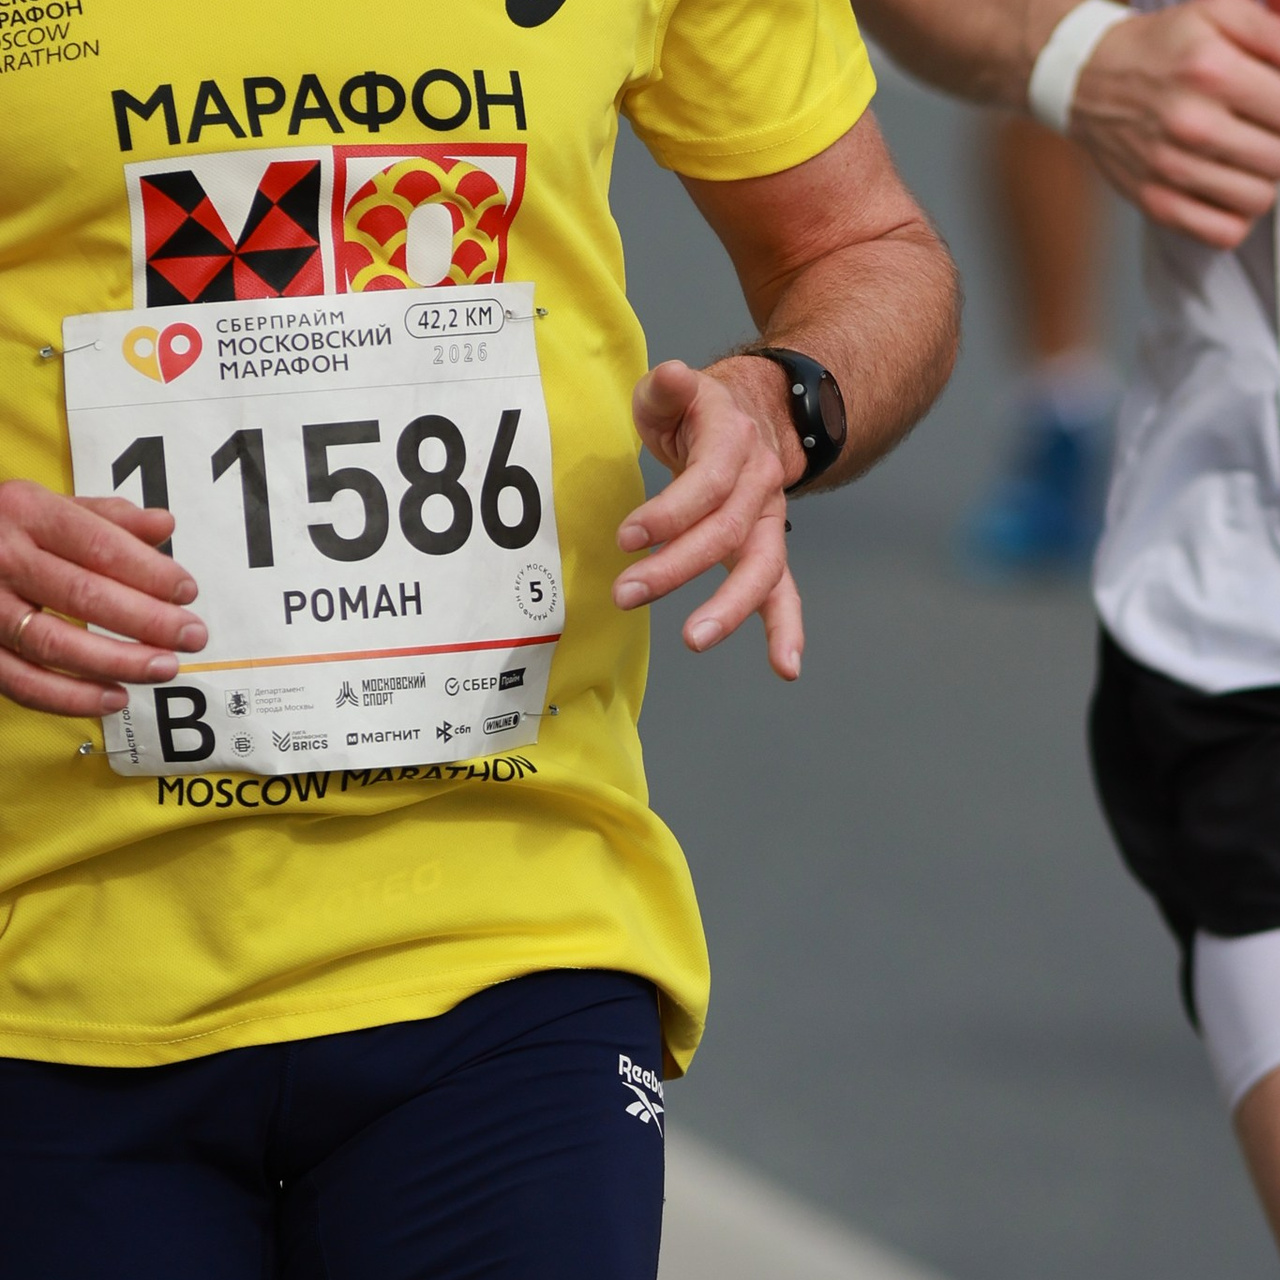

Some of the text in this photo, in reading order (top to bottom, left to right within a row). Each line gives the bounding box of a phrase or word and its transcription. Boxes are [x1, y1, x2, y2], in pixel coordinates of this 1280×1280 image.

[0, 39, 99, 74] RATHON
[111, 69, 527, 152] МАРАФОН
[216, 311, 345, 333] СБЕРПРАЙМ
[418, 309, 458, 331] 42,2
[217, 324, 392, 357] МОСКОВСКИЙ
[433, 342, 488, 365] 2026
[219, 354, 349, 380] МАРАФОН
[111, 409, 542, 569] 11586
[283, 581, 423, 624] РОМАН
[529, 580, 544, 603] 5
[361, 672, 427, 692] МОСКОВСКИЙ
[462, 677, 498, 692] СБЕР
[363, 692, 394, 706] СПОРТ
[454, 725, 472, 735] сбп
[486, 716, 513, 732] WINLINE
[292, 739, 329, 751] BRICS
[361, 728, 421, 744] магнит
[158, 754, 538, 808] MOSCOW MARATHON
[619, 1054, 664, 1104] Reebo
